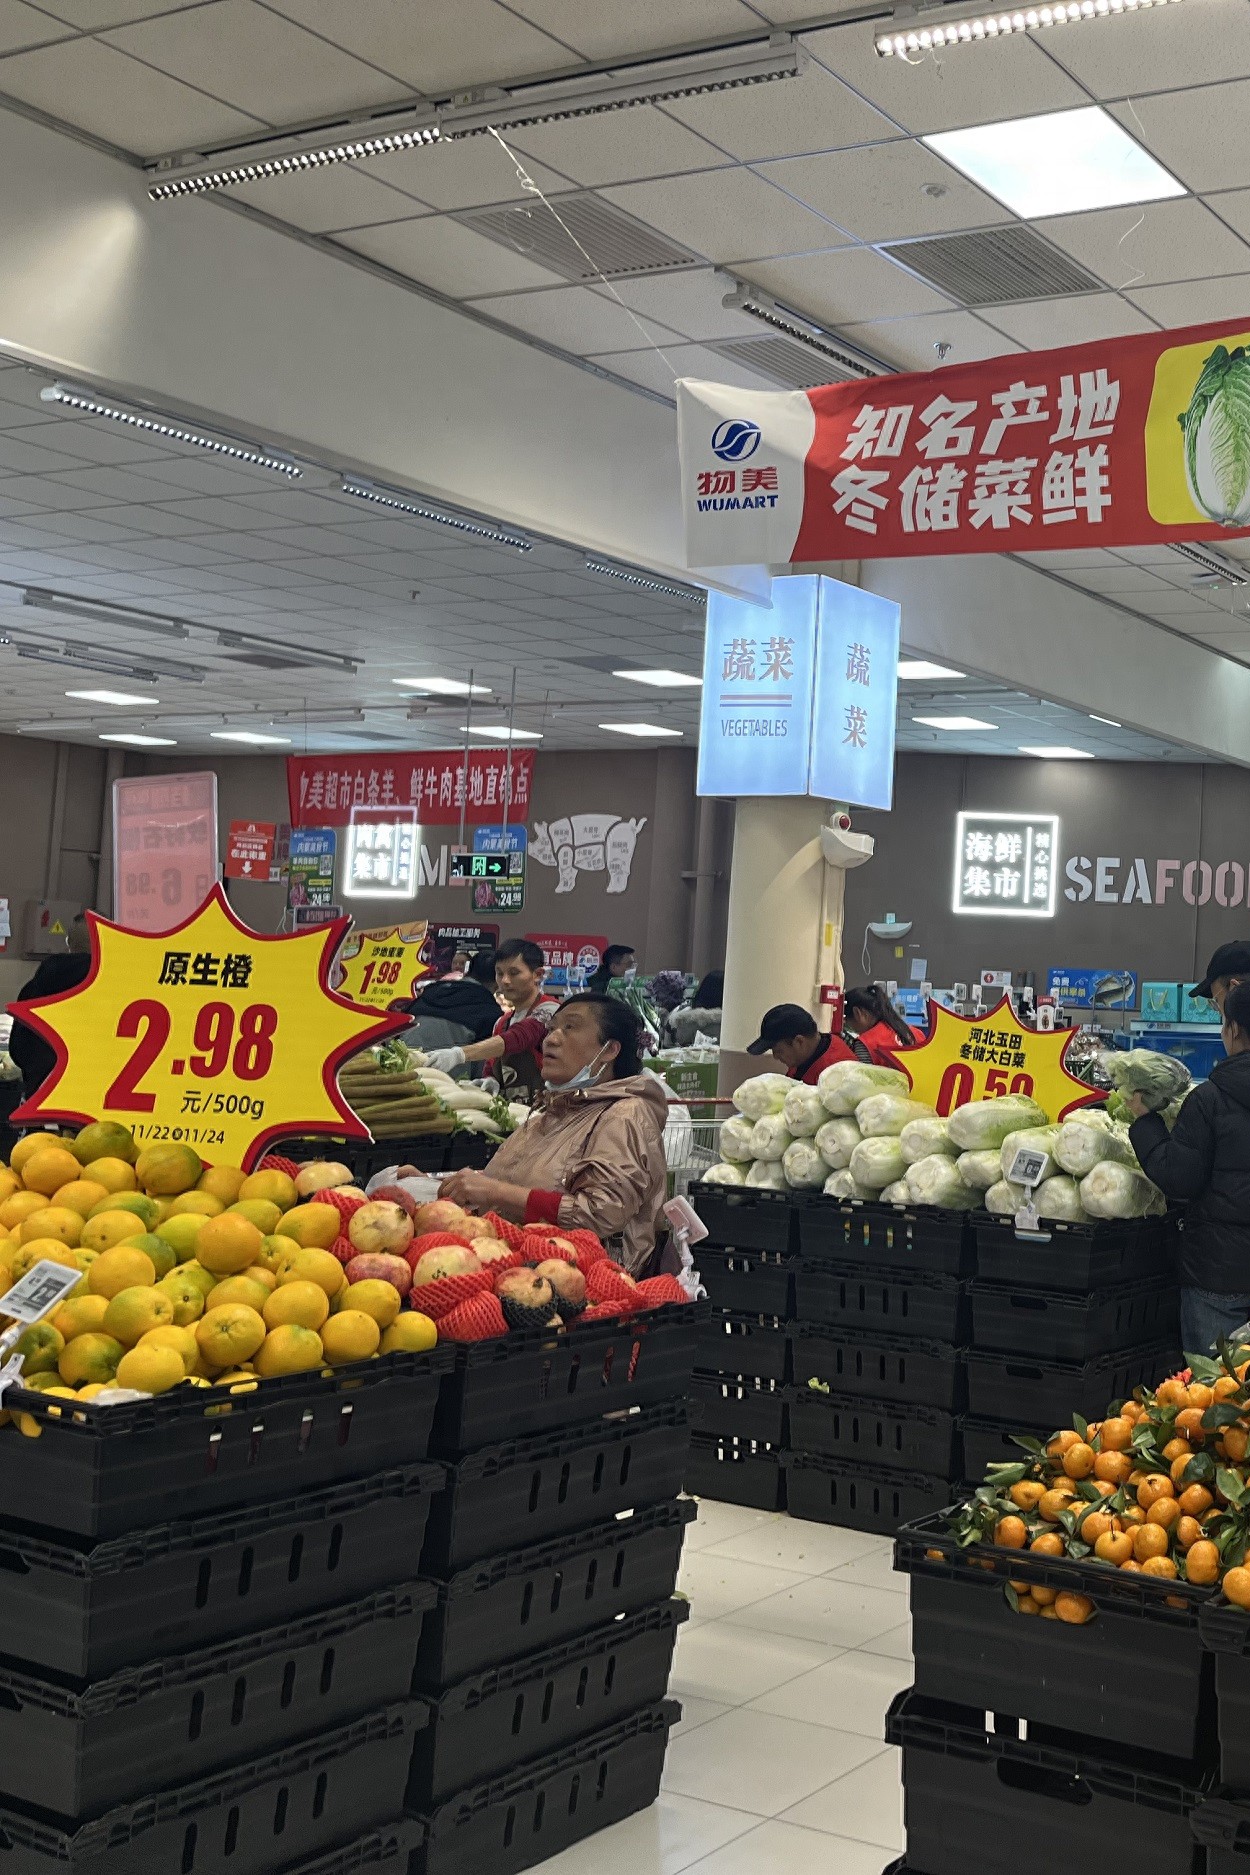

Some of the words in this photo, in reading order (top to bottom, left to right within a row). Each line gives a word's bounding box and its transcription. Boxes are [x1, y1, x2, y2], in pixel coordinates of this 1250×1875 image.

[840, 369, 1120, 461] 知名产地
[697, 466, 778, 495] 物美
[831, 444, 1111, 534] 冬储菜鲜
[697, 495, 779, 512] WUMART
[722, 637, 795, 682] 蔬菜
[842, 643, 871, 749] 蔬菜
[721, 719, 788, 737] VEGETABLES
[966, 832, 1022, 864] 海鲜
[963, 866, 1021, 898] 集市
[158, 951, 253, 989] 原生橙
[543, 951, 574, 967] 有品牌
[359, 961, 402, 994] 1.98
[1051, 987, 1086, 997] 供宰杀
[968, 1026, 1023, 1051] 河北玉田
[103, 999, 279, 1114] 2.98
[960, 1043, 1026, 1068] 冬储大白菜
[180, 1090, 265, 1120] 元/500g
[936, 1062, 1034, 1117] 059
